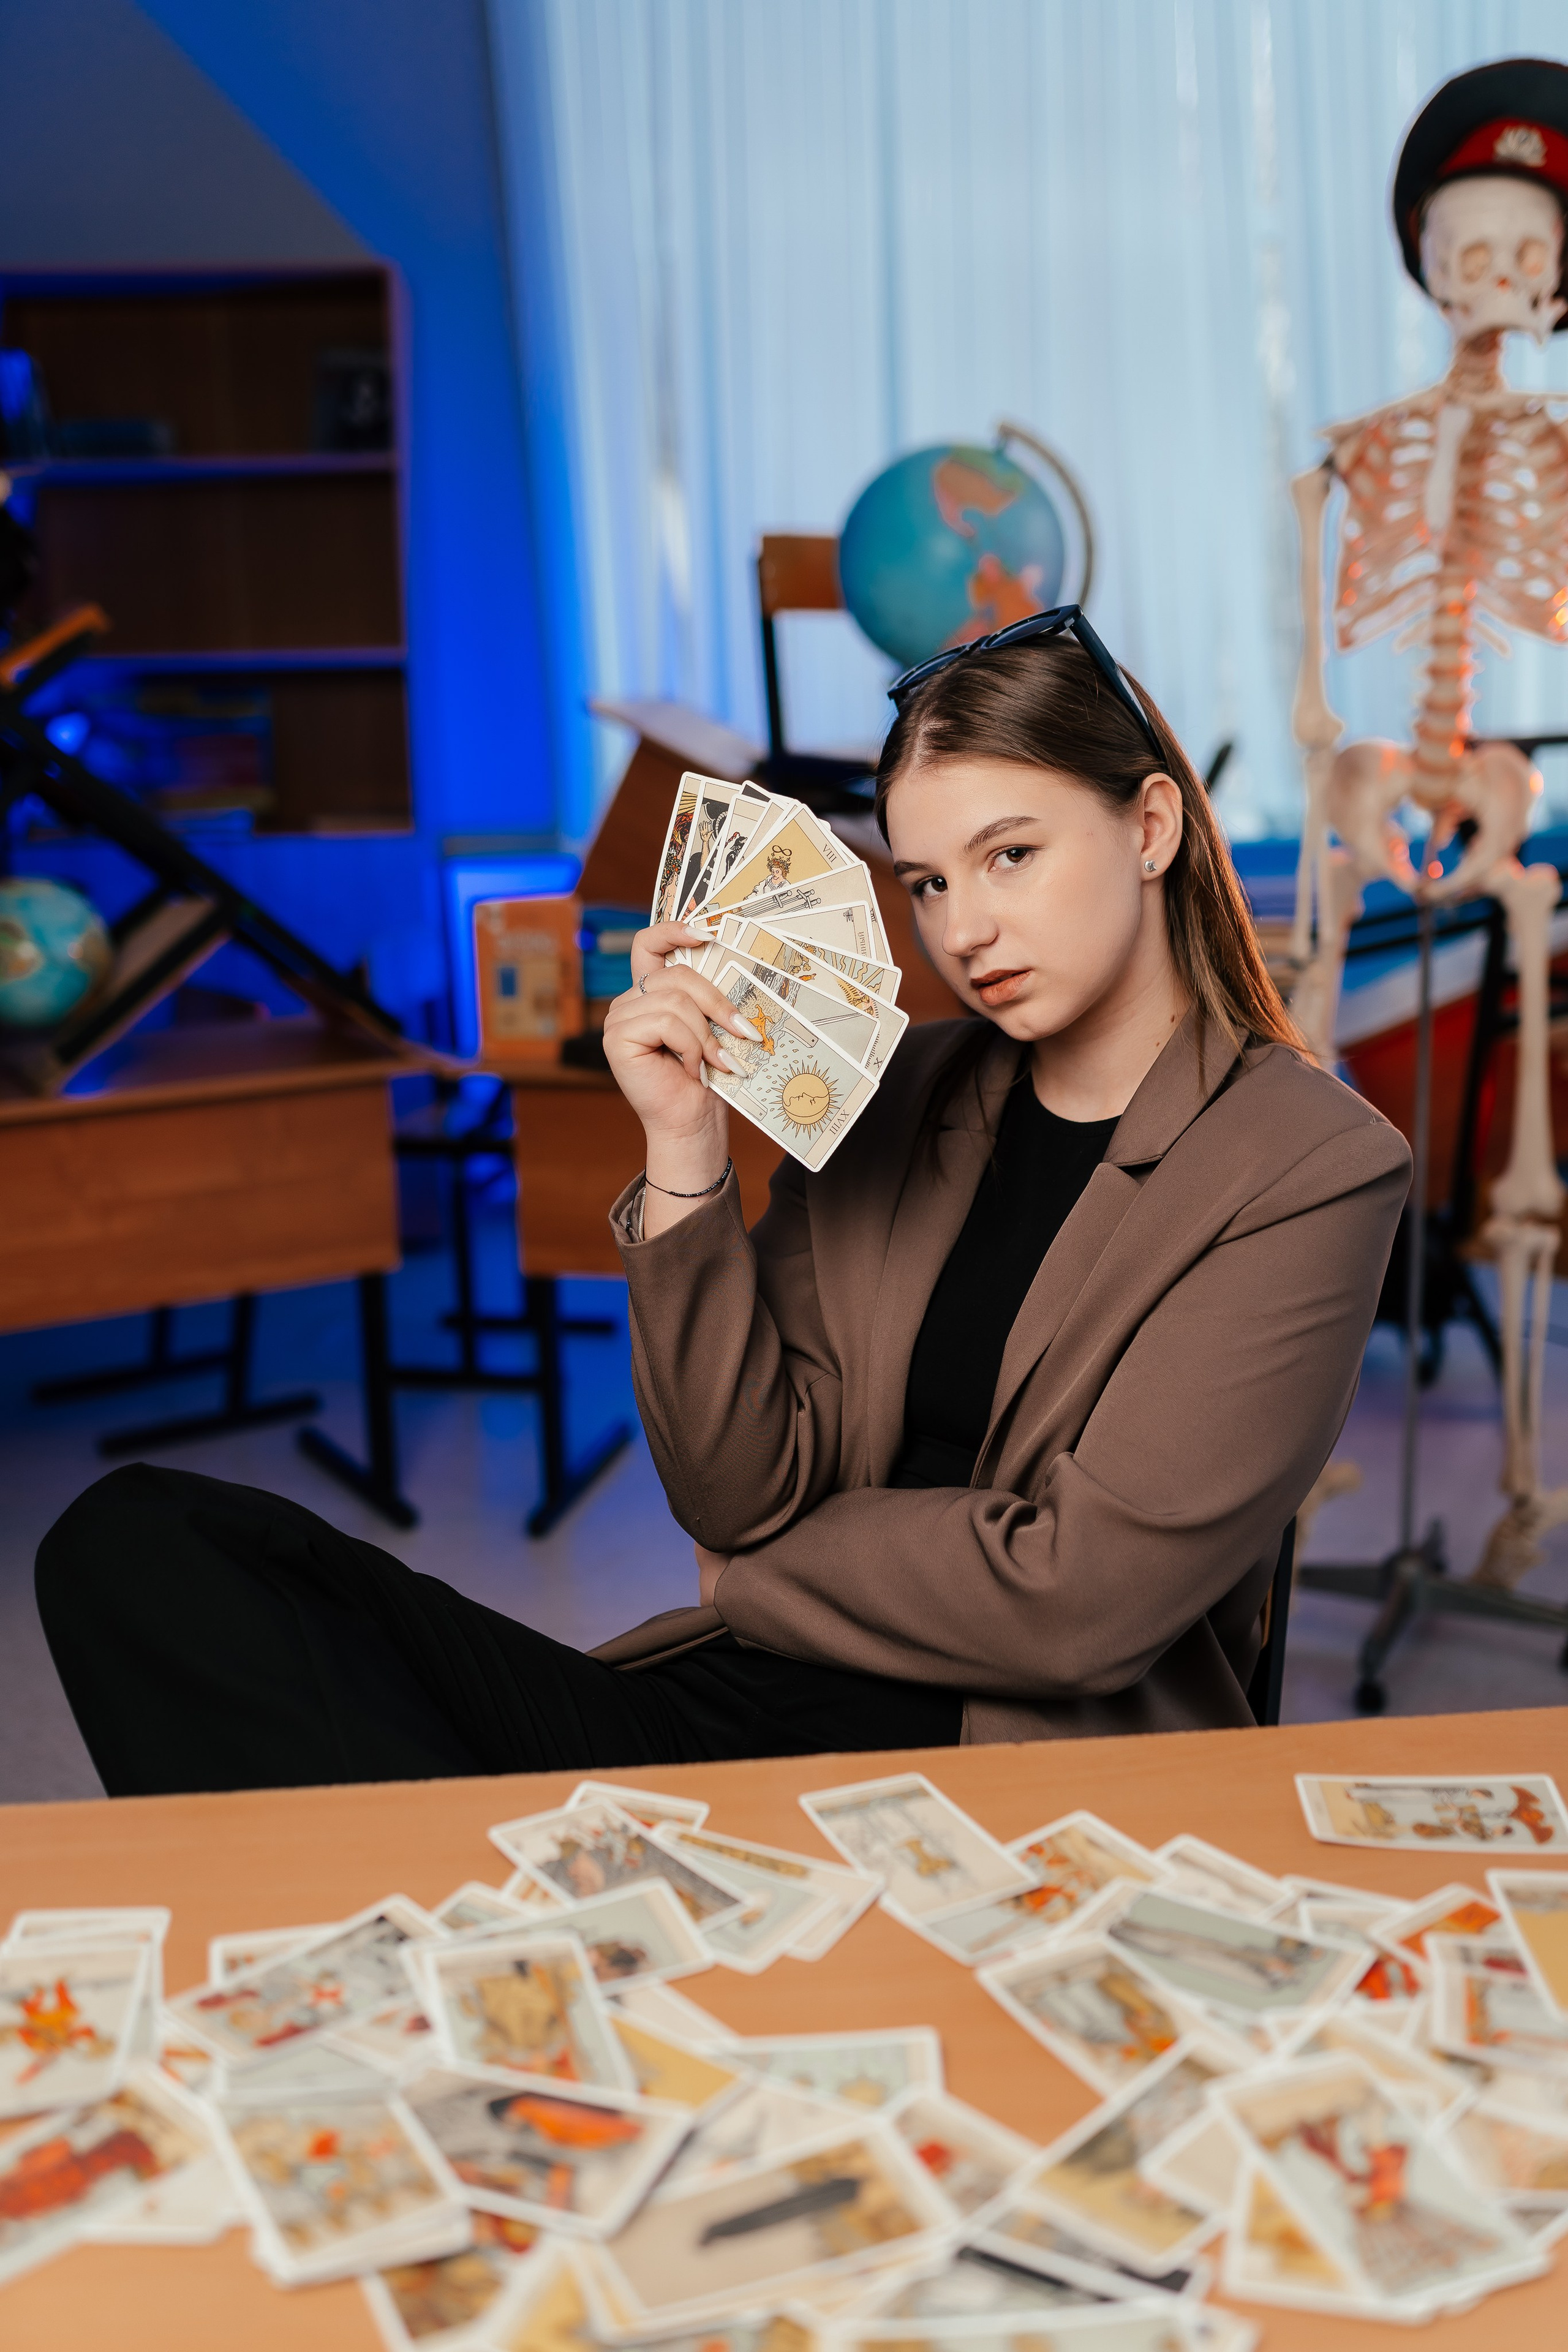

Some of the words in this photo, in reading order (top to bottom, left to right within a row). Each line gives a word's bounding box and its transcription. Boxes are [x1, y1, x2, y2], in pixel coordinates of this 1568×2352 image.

[823, 843, 837, 863] VIII
[873, 1057, 883, 1069] X
[829, 1109, 850, 1135] XVIII
